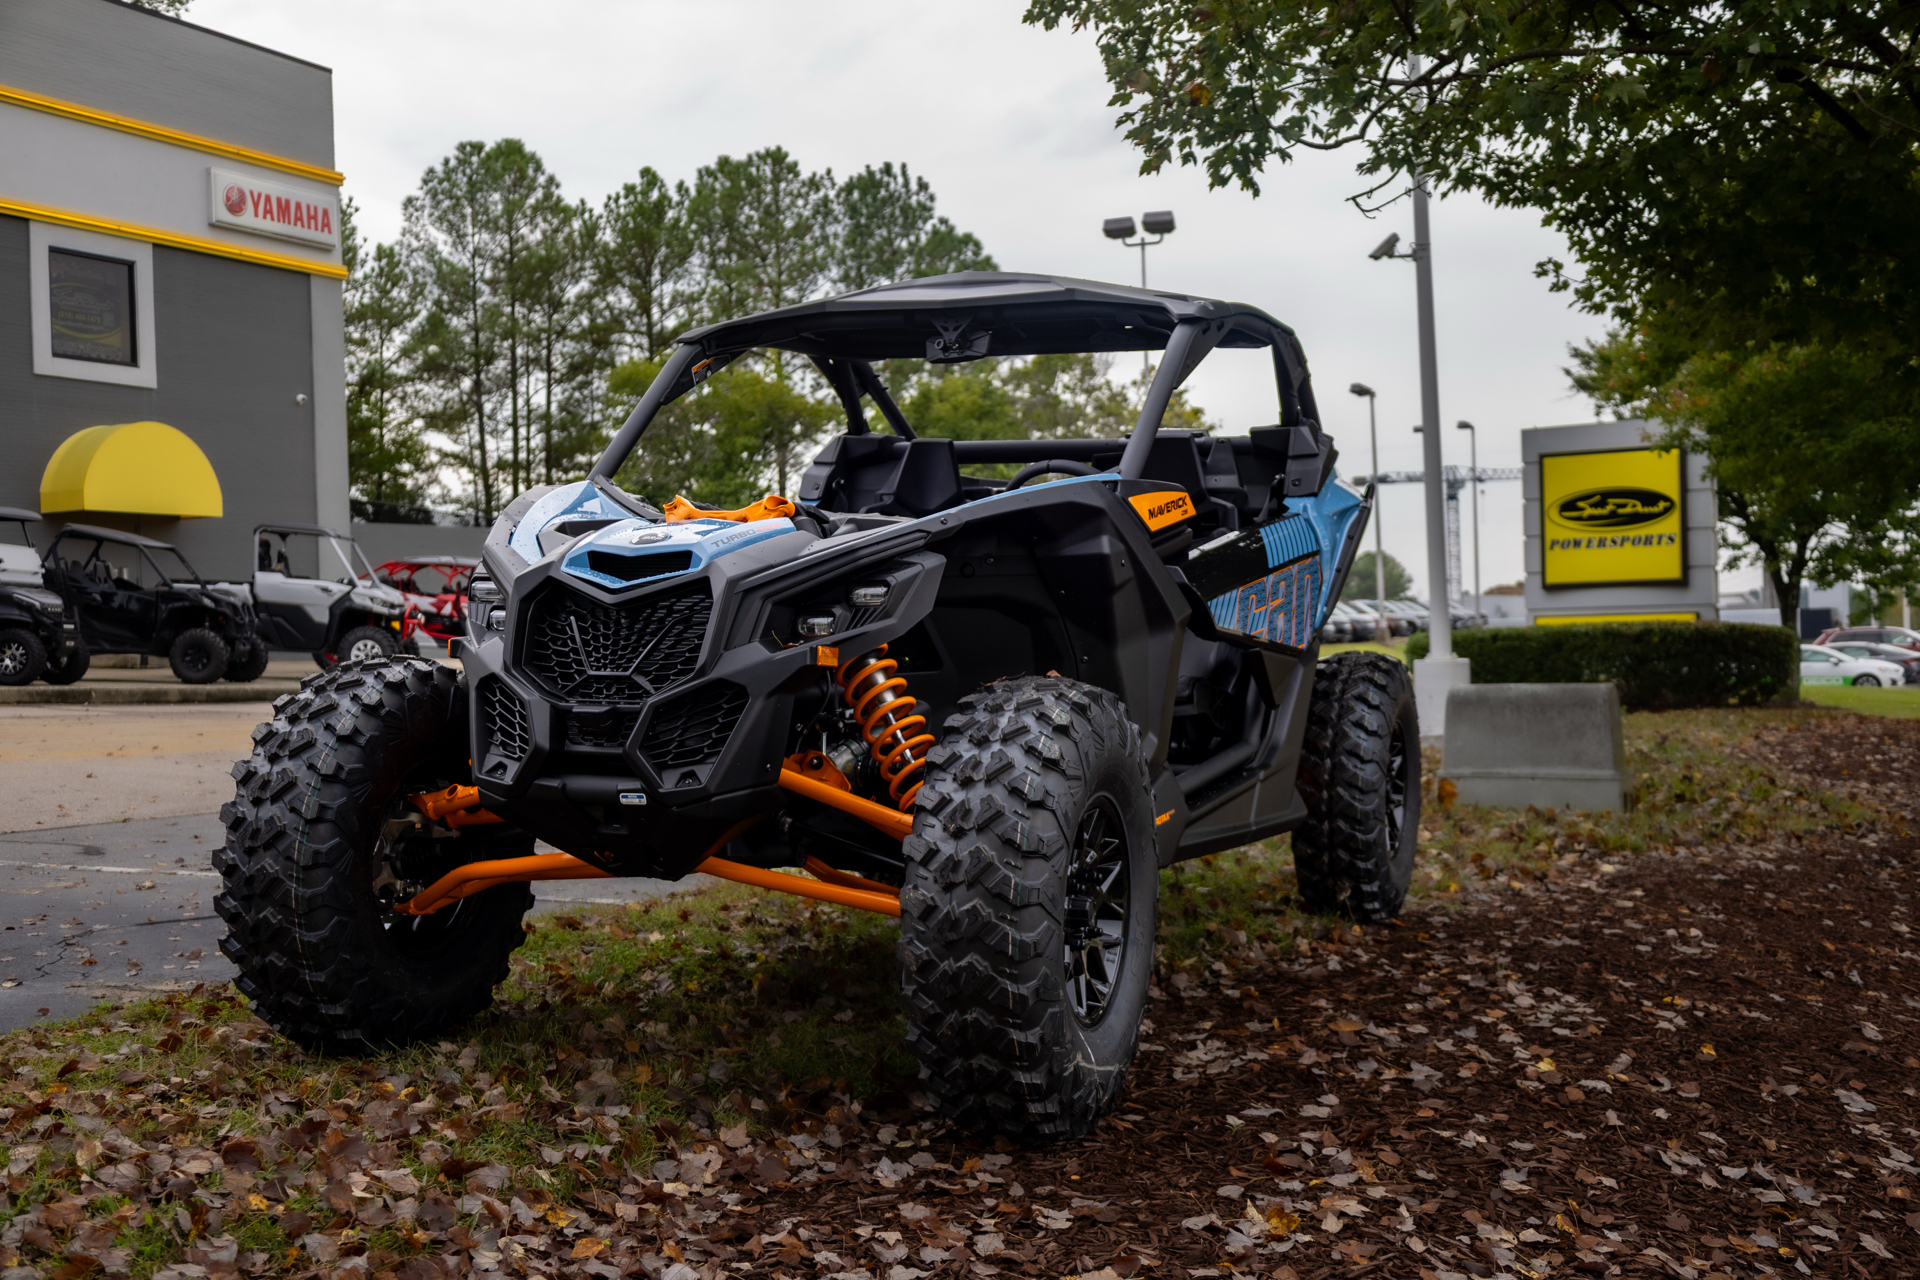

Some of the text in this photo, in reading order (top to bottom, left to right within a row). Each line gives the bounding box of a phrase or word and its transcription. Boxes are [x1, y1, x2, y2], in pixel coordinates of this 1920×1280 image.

[249, 189, 332, 235] YAMAHA
[1148, 495, 1188, 520] MAVERICK
[711, 523, 784, 548] TURBO RR
[1549, 533, 1677, 551] POWERSPORTS
